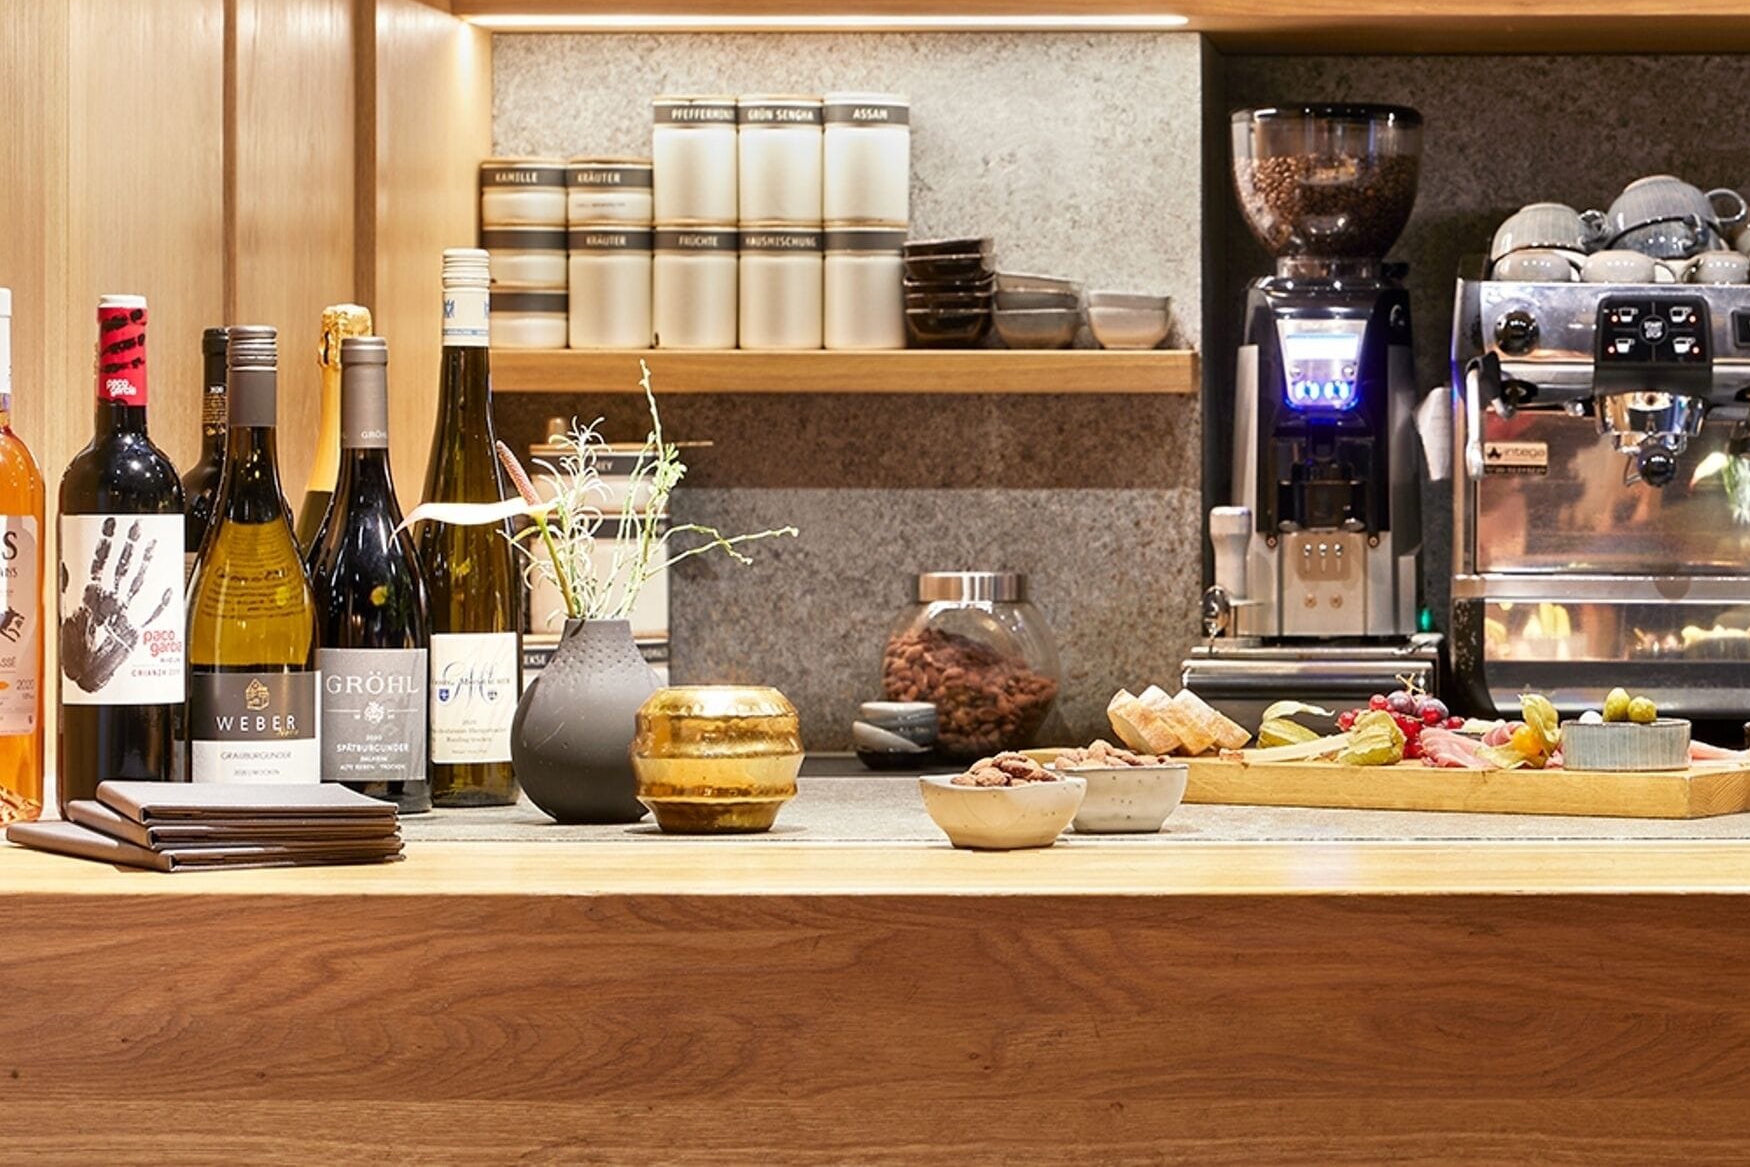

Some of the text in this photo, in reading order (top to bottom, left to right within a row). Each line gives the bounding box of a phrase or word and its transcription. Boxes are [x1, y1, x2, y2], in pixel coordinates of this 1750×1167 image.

[852, 109, 888, 120] ASSAM
[495, 172, 538, 184] KAMILLE
[577, 171, 621, 184] KRÄUTER
[586, 236, 627, 247] KRÄUTER
[678, 235, 718, 247] FRÜCHTE
[143, 630, 176, 645] paco
[326, 670, 419, 695] GRÖHL
[216, 715, 296, 732] WEBER
[336, 743, 409, 753] SPÄTBURGUNDER
